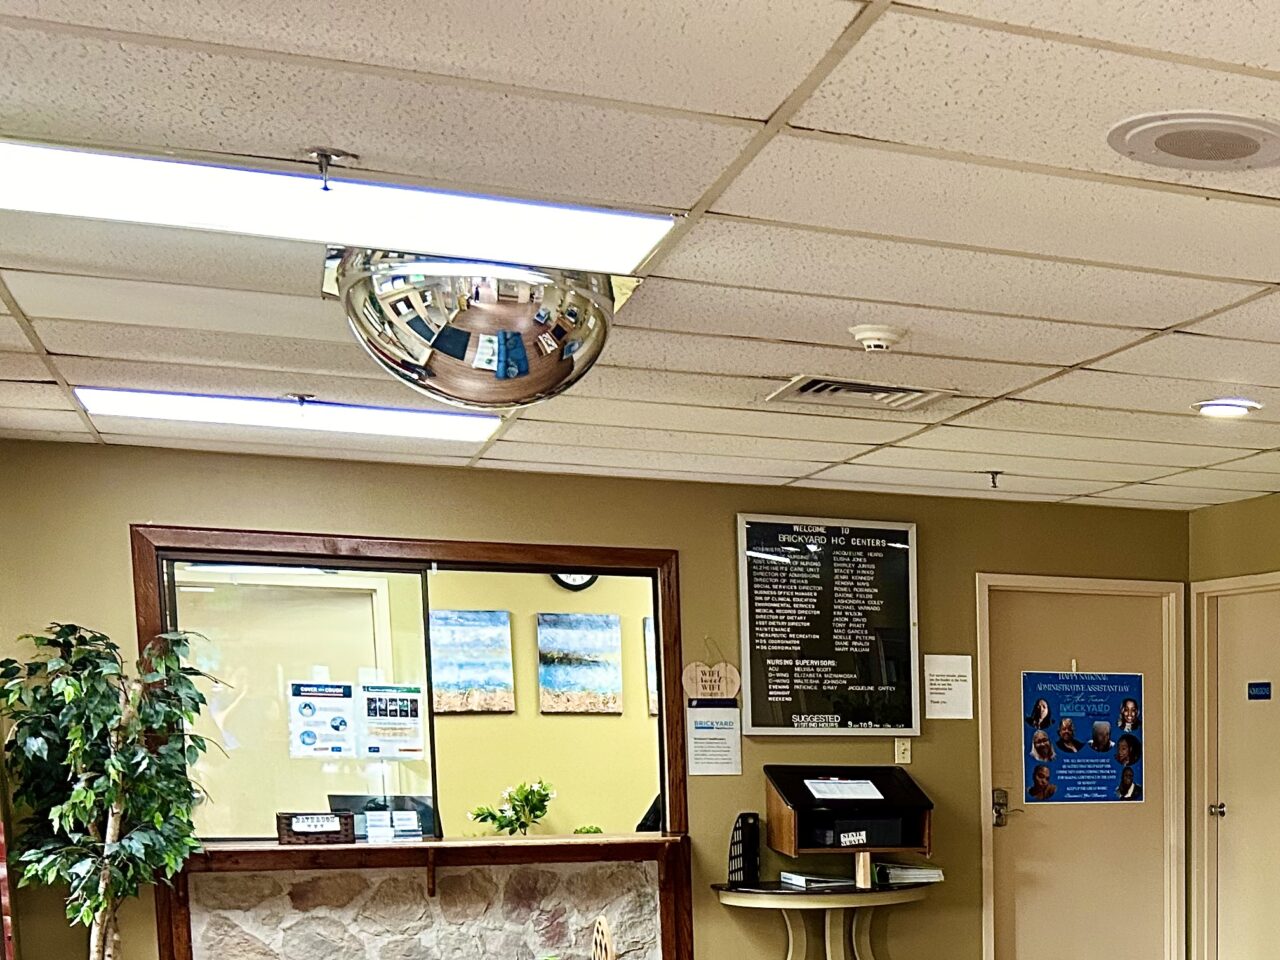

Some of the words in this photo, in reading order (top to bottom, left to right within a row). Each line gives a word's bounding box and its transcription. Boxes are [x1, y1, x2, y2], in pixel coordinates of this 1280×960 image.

[793, 525, 826, 533] WELCOME
[778, 534, 826, 544] BRICKYARD
[832, 537, 845, 545] HC
[851, 538, 886, 546] CENTERS
[1059, 704, 1110, 712] BRICKYARD
[792, 714, 840, 722] SUGGESTED
